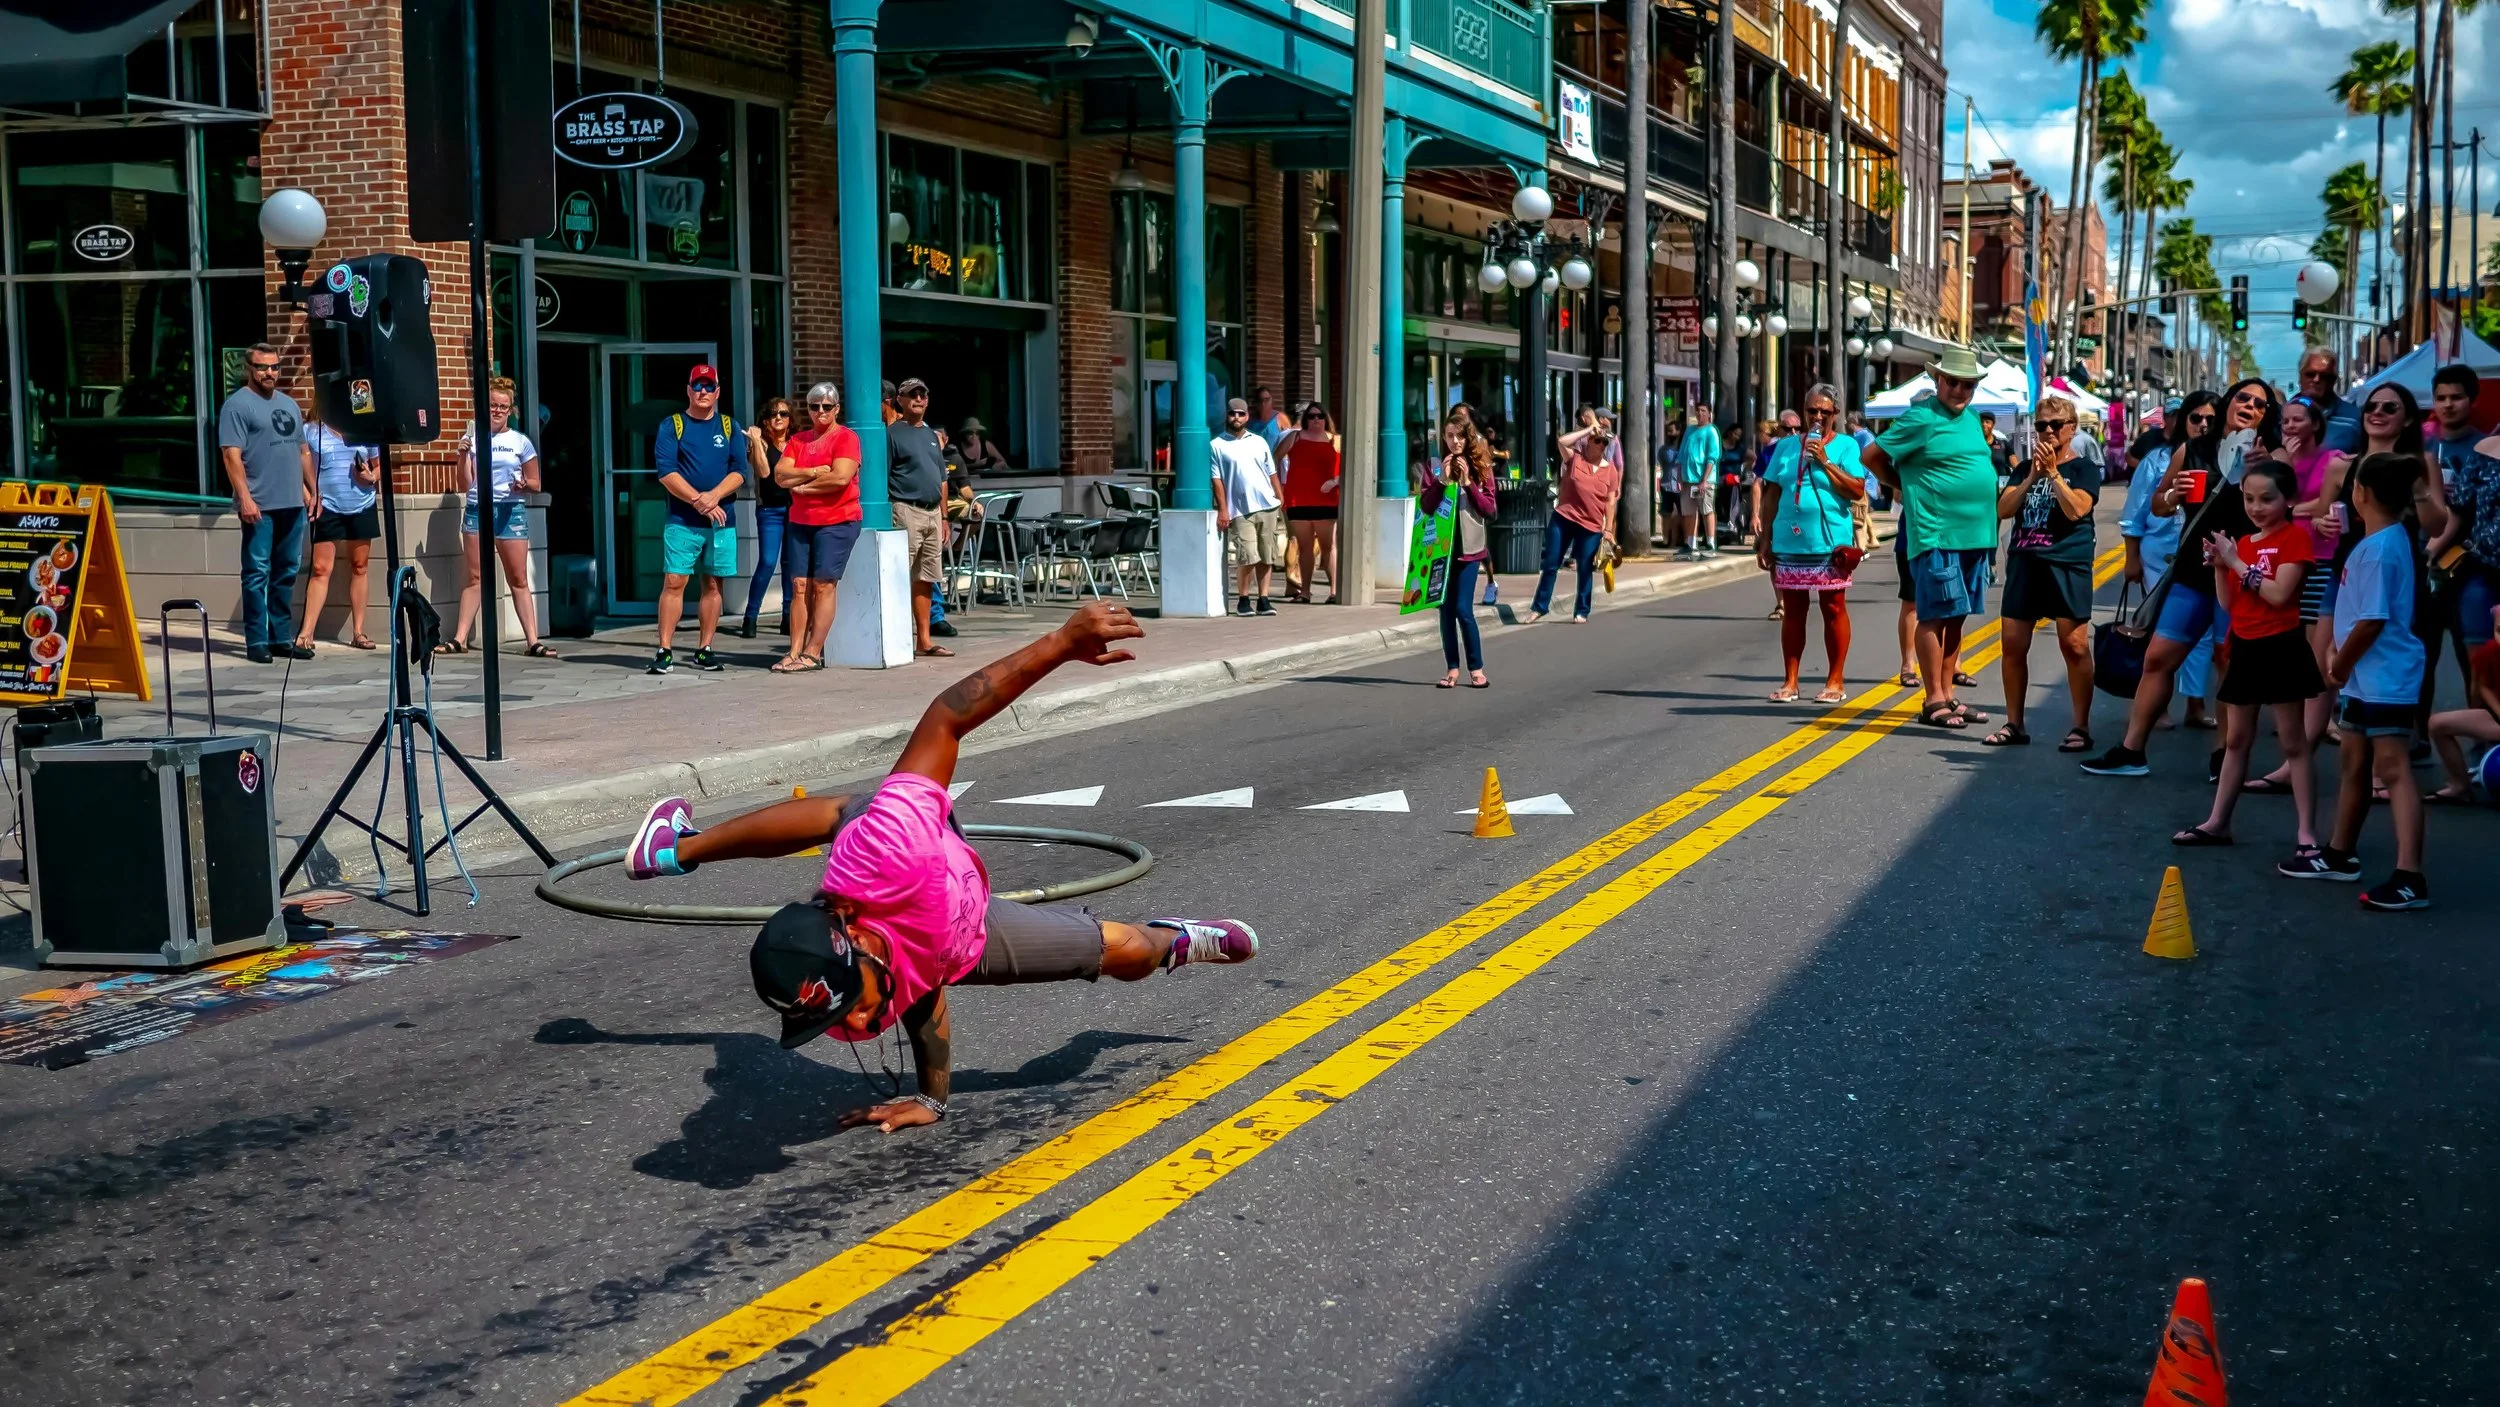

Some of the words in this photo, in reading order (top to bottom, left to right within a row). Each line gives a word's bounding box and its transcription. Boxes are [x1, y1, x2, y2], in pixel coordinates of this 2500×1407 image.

[578, 112, 596, 121] THE
[566, 120, 625, 138] BRASS
[629, 118, 666, 135] TAP
[81, 238, 109, 247] BRASS
[110, 237, 127, 246] TAP
[498, 445, 514, 453] Klein
[18, 515, 60, 528] ASIATIC
